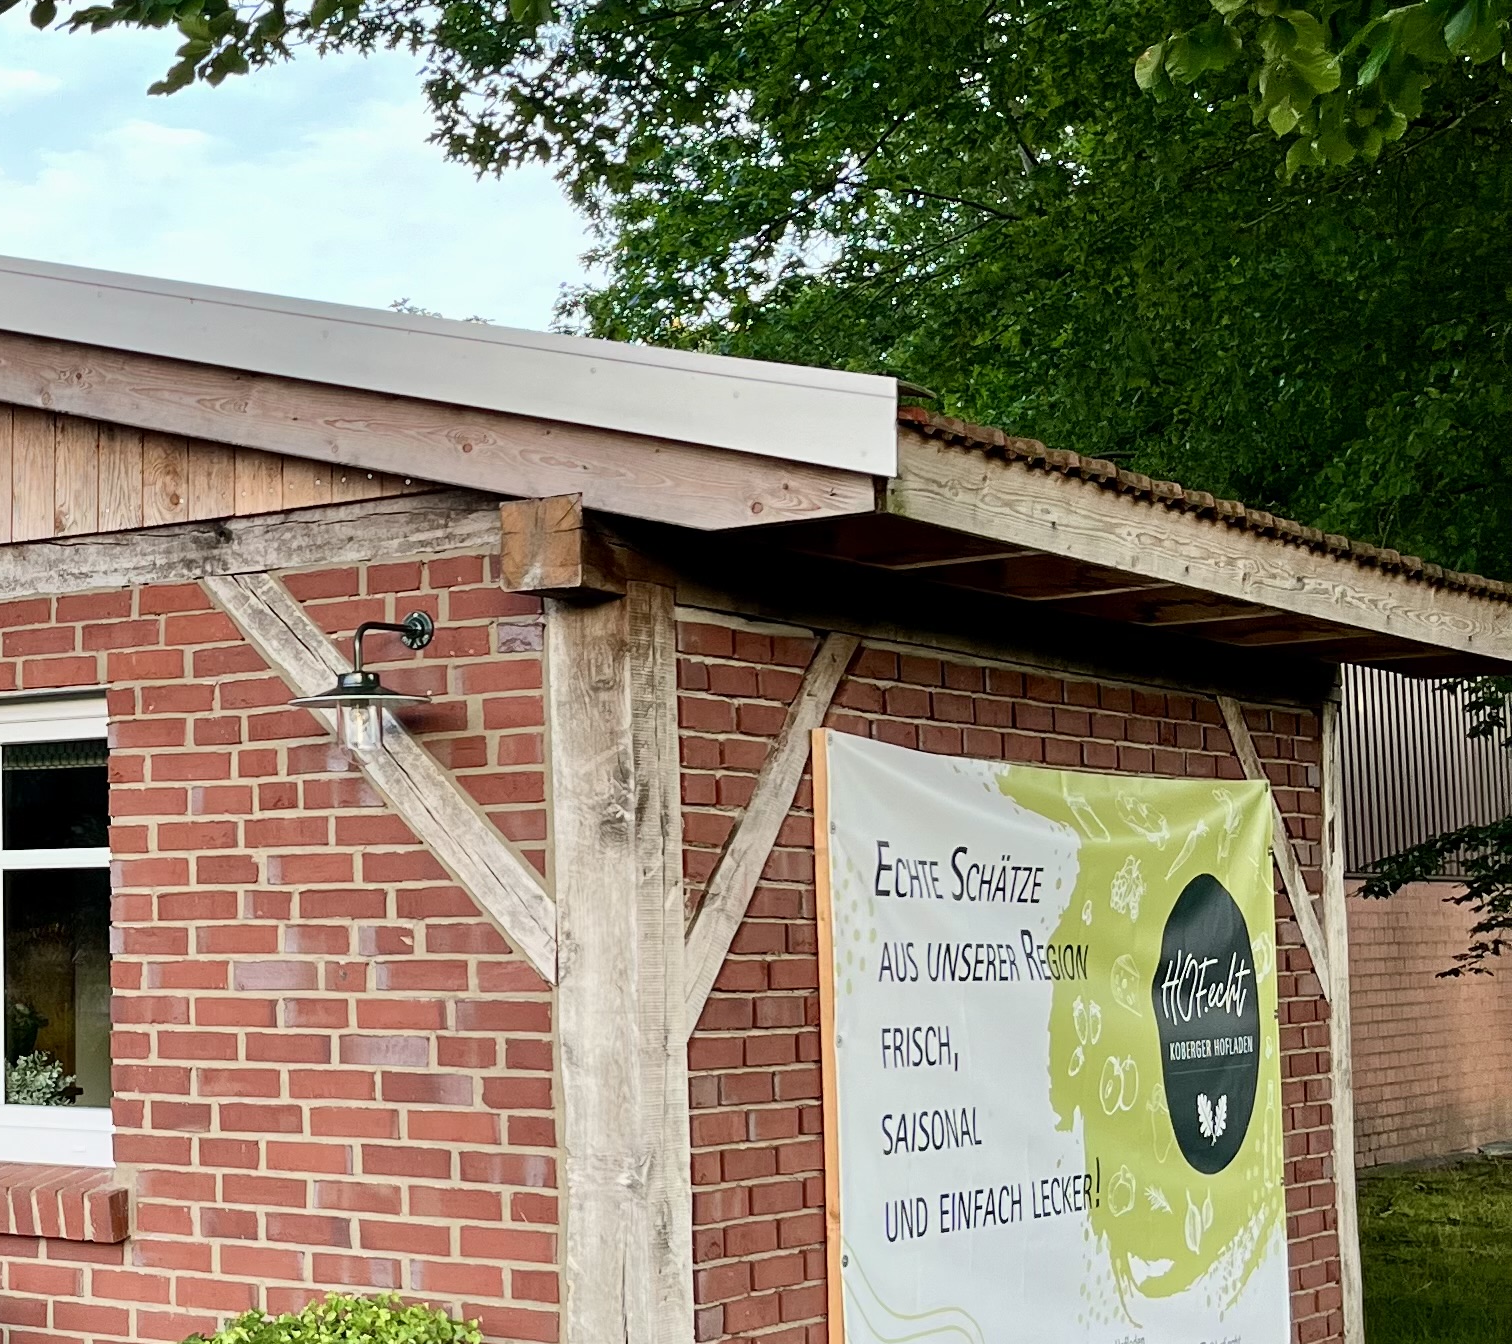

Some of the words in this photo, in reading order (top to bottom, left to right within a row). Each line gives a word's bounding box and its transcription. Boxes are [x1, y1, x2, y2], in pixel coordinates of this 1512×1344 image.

[879, 942, 919, 982] AUS
[927, 942, 1021, 982] UNSERER
[881, 1025, 959, 1072] FRISCH,
[1169, 1039, 1212, 1061] KOBERGER
[1213, 1035, 1254, 1056] HOFLADEN
[881, 1106, 983, 1156] SAISONAL
[885, 1197, 928, 1243] UND
[939, 1183, 1023, 1234] EINFACH
[1031, 1156, 1101, 1219] LECKER!
